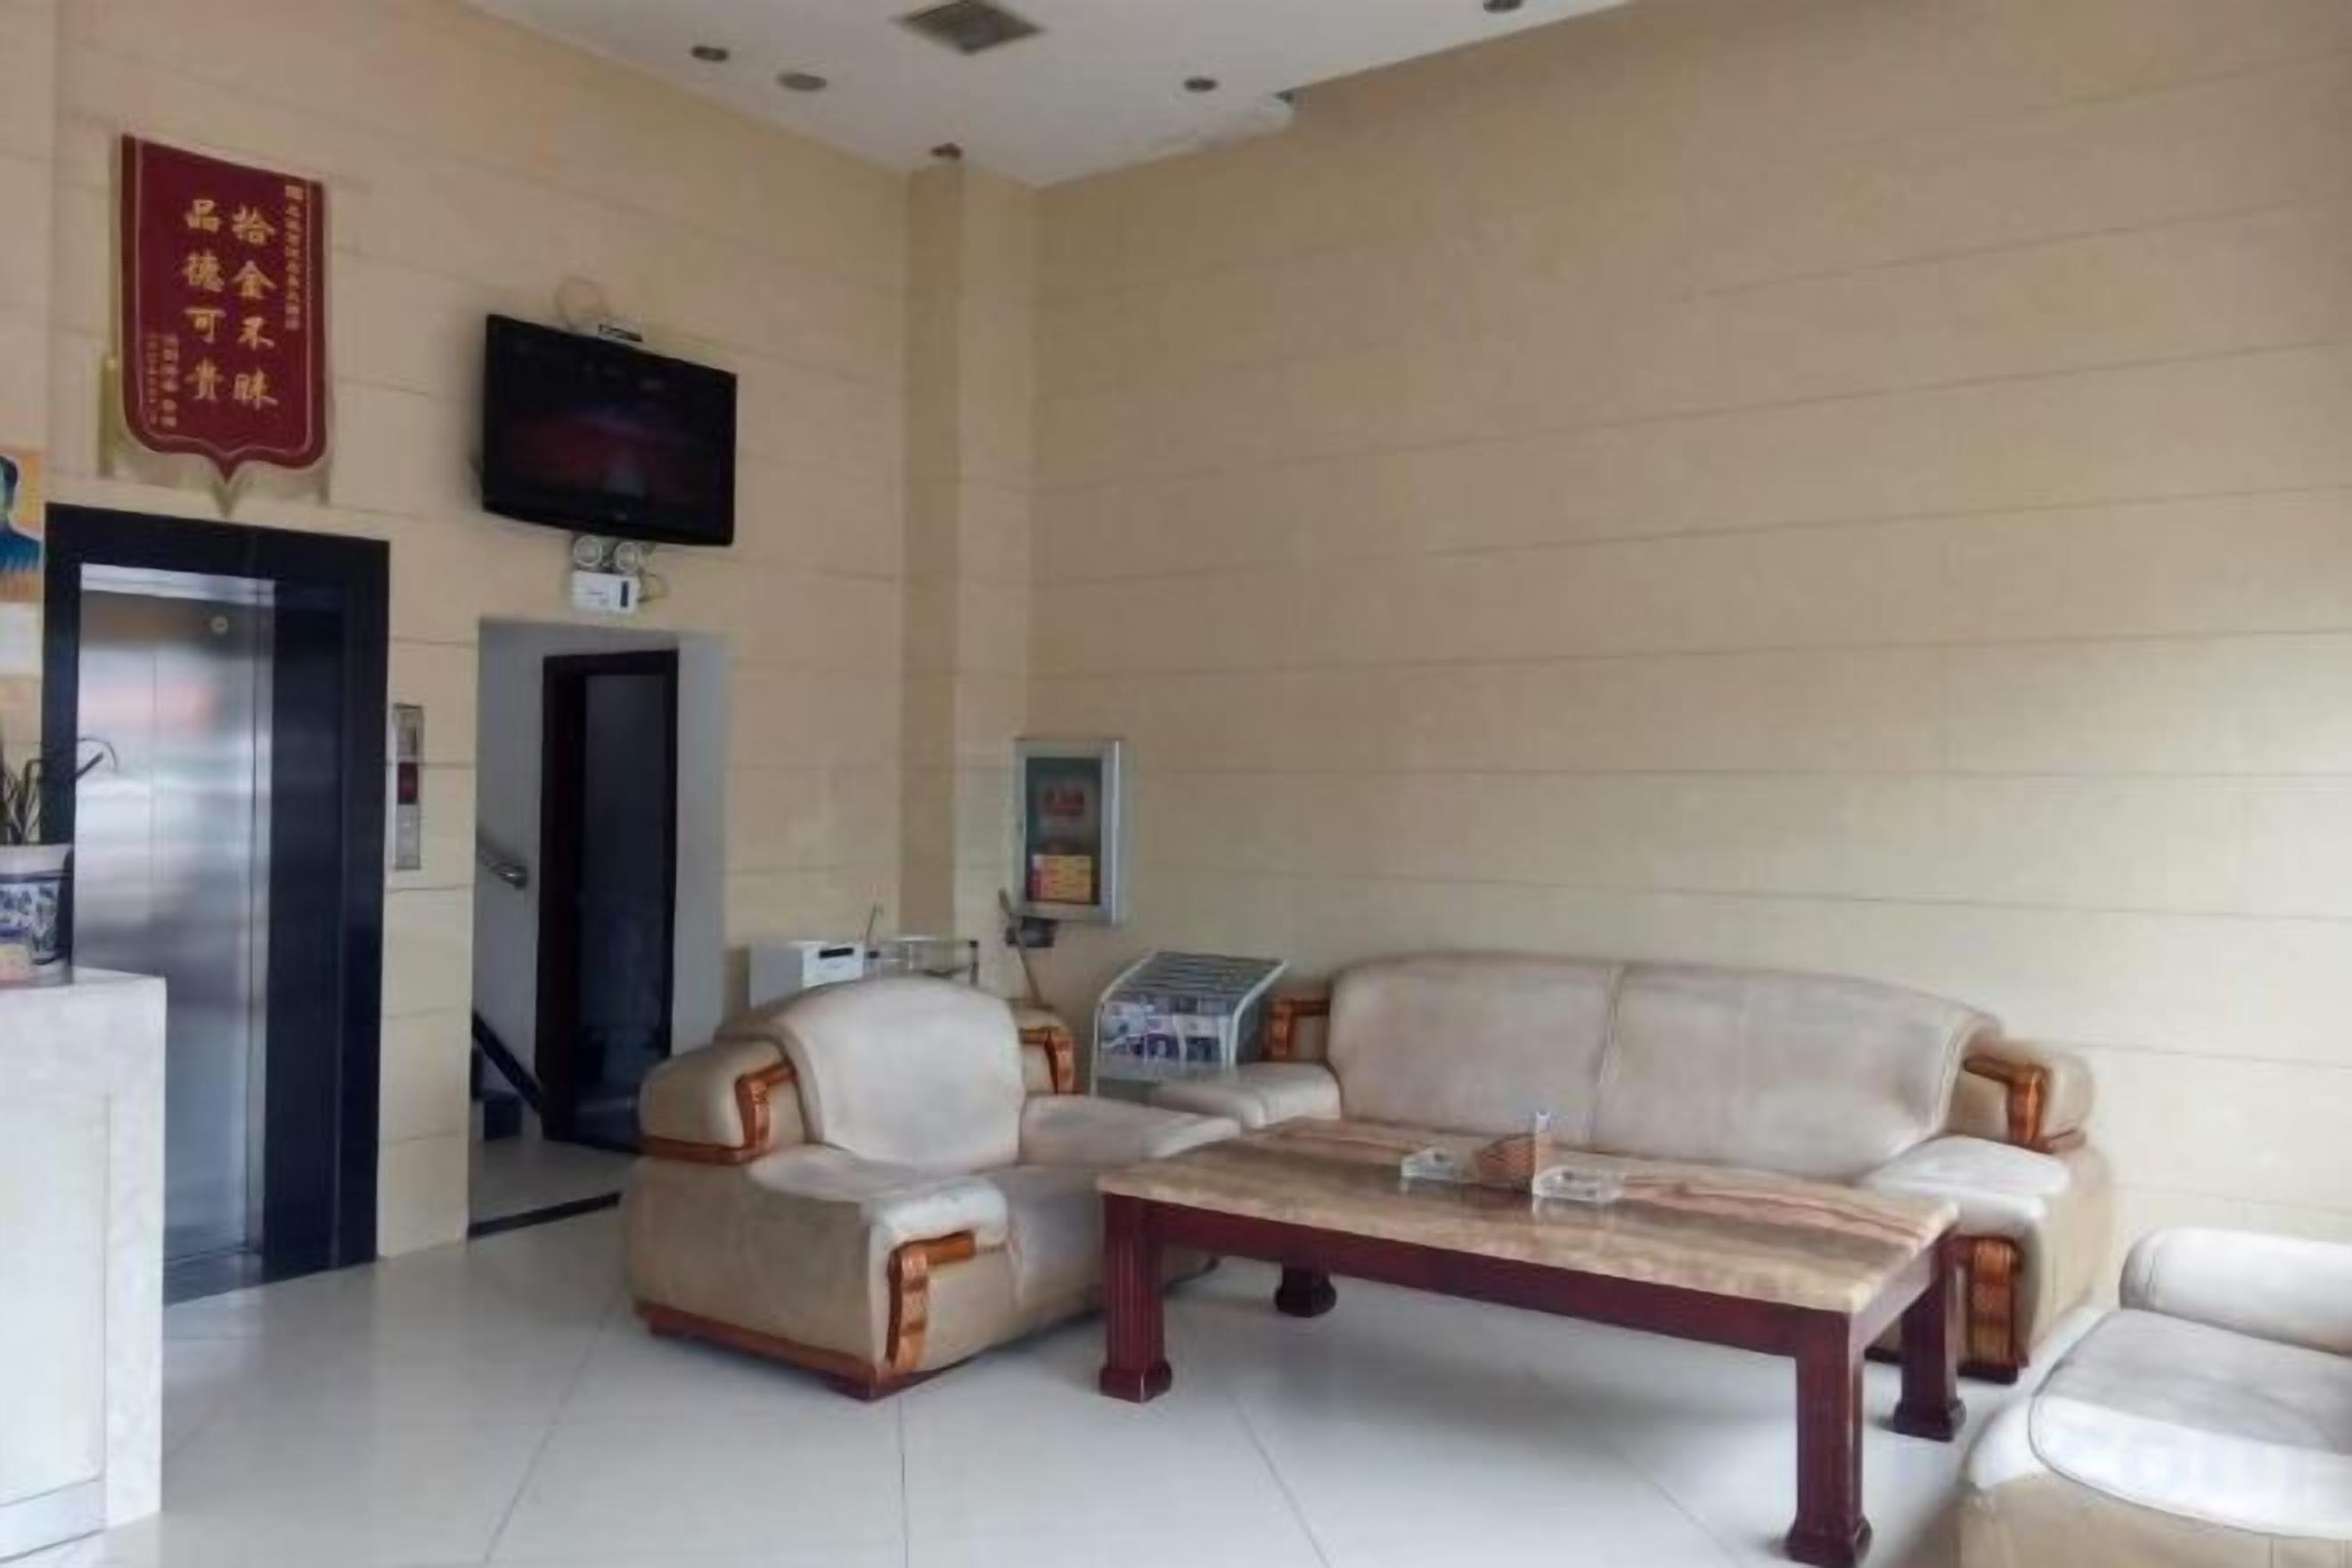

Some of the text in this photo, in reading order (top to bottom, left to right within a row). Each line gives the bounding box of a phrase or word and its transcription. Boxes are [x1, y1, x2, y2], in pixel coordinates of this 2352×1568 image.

[182, 198, 227, 401] 品德可贵
[231, 205, 278, 411] 拾金不昧
